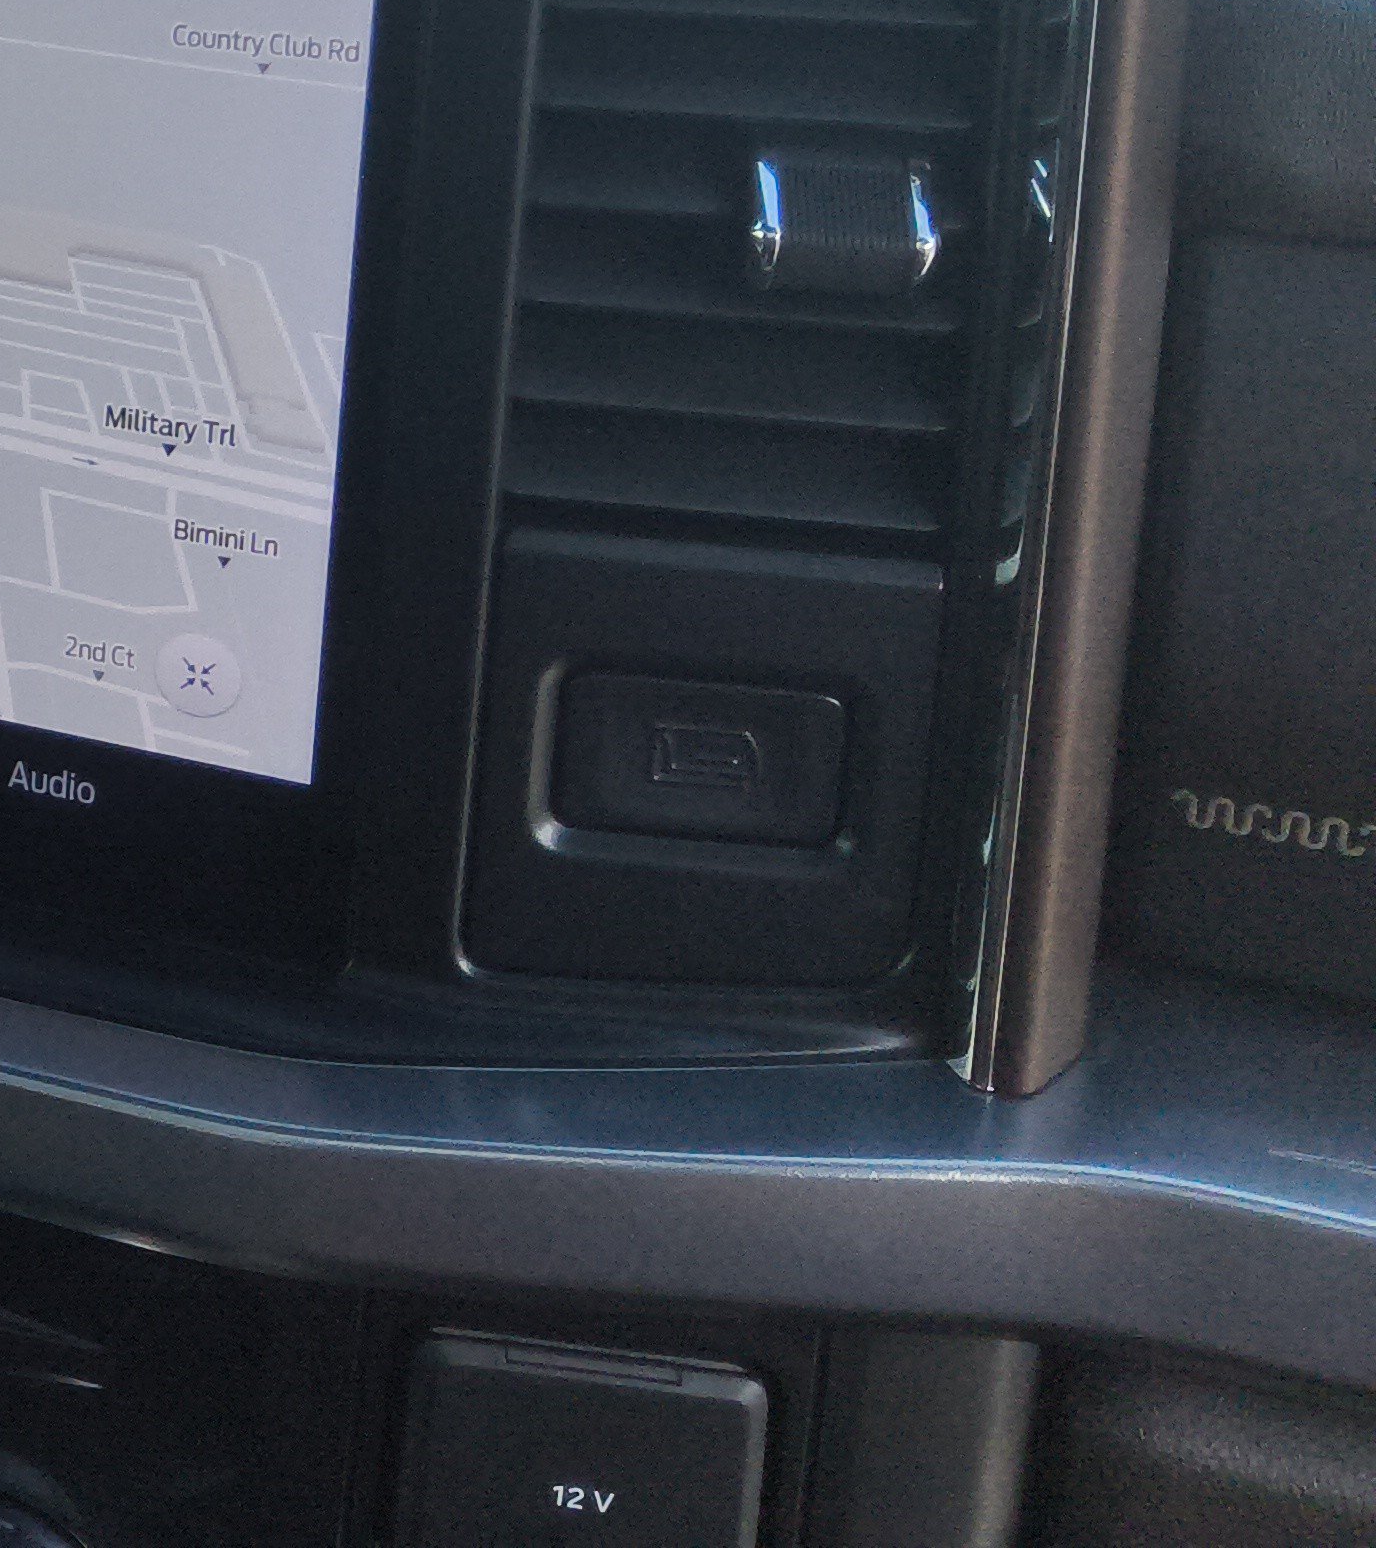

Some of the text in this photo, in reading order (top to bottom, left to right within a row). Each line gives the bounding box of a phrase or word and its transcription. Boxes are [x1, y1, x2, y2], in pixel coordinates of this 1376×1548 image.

[171, 25, 361, 63] Country Club Rd
[104, 406, 236, 447] Military Trl
[173, 518, 279, 557] Bimini Ln
[64, 636, 136, 670] 2nd Ct
[7, 762, 97, 805] Audio
[552, 1485, 615, 1513] 12 V
